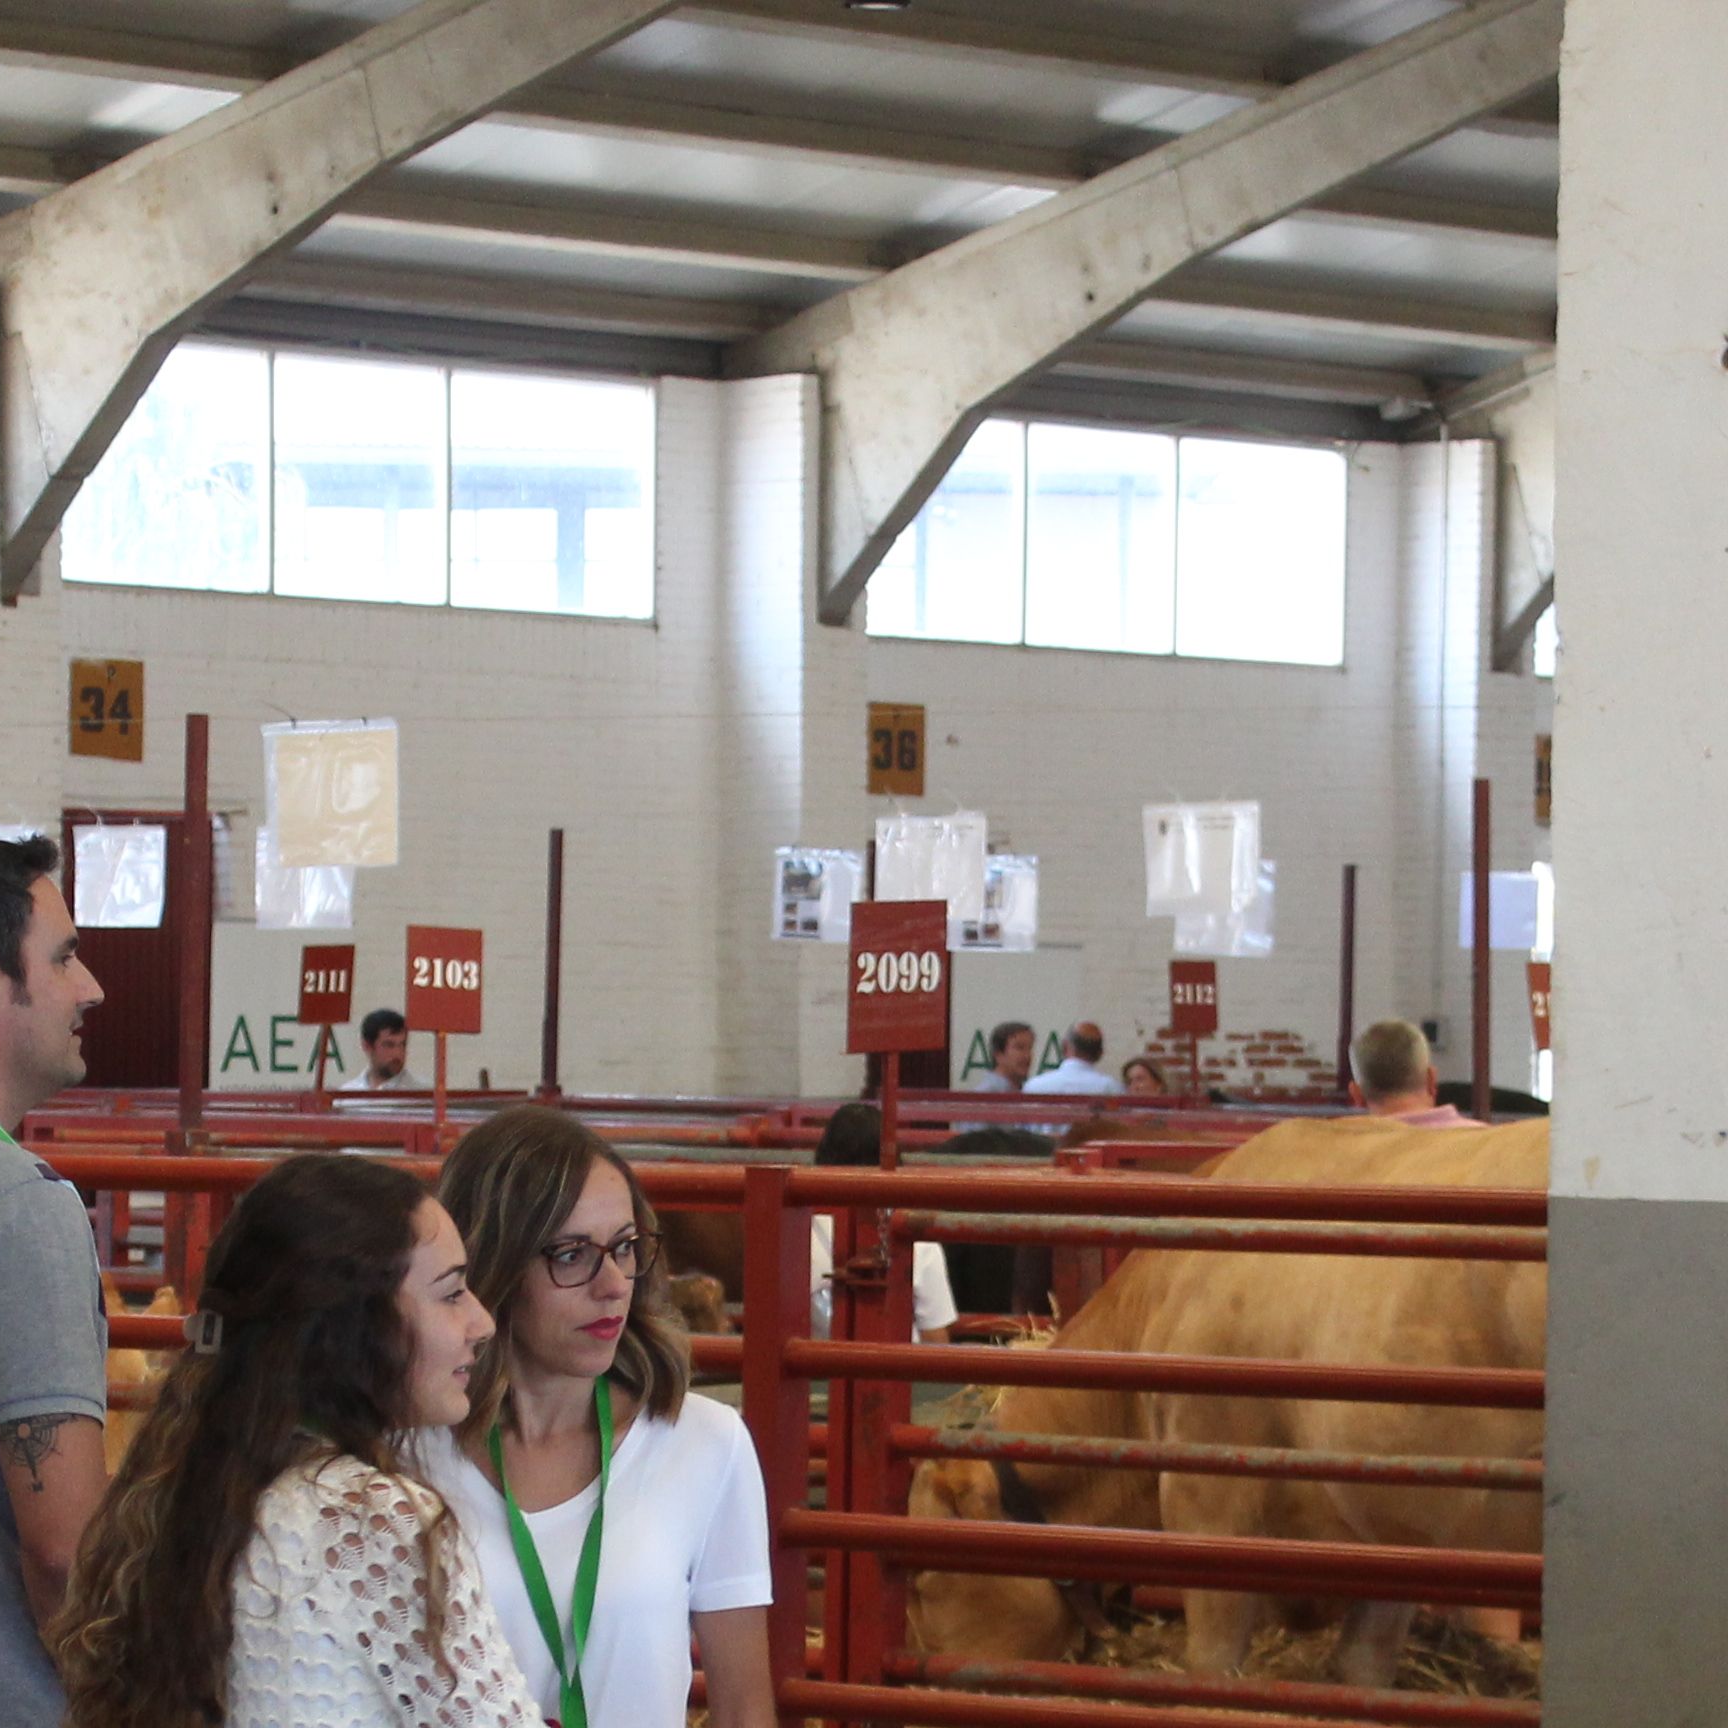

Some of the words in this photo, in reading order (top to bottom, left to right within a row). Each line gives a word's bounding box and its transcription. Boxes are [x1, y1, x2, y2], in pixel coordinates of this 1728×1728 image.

[79, 686, 133, 736] 34
[303, 969, 347, 993] 2111
[413, 956, 479, 990] 2103
[856, 950, 940, 994] 2099
[1172, 982, 1214, 1005] 2112
